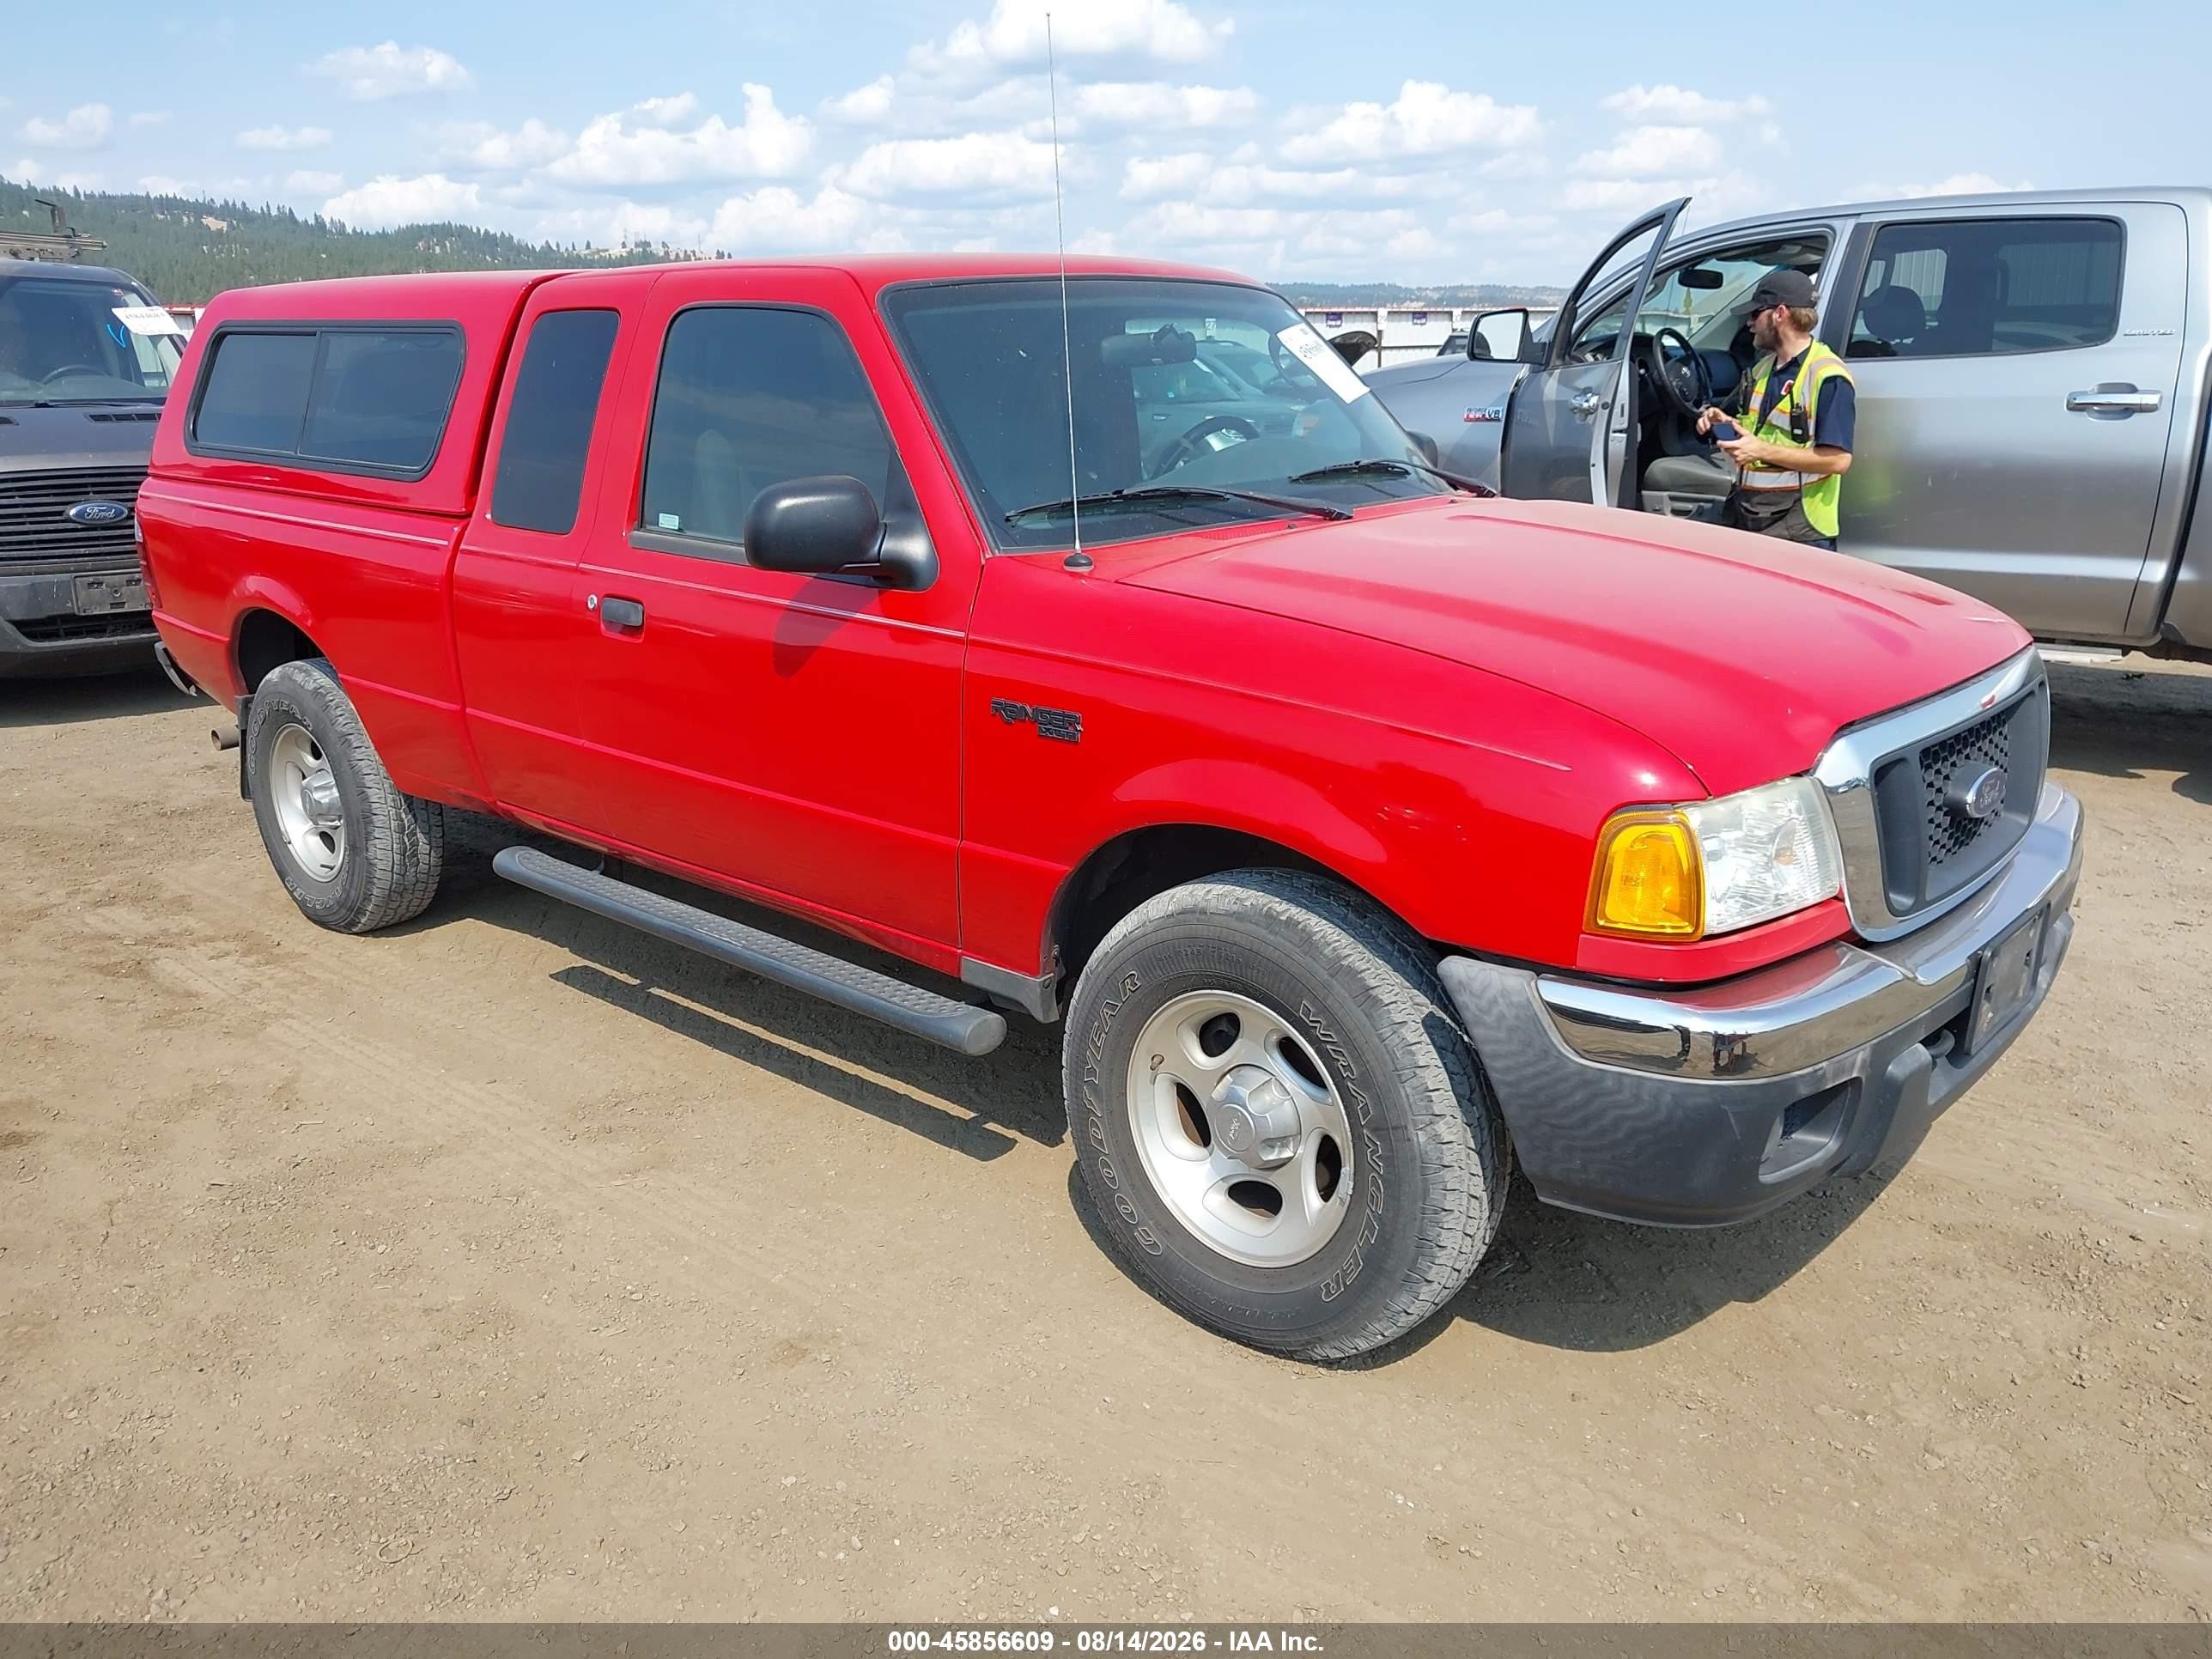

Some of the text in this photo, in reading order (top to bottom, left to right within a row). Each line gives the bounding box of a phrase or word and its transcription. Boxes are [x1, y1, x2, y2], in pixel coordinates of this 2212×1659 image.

[84, 506, 117, 520] Ford
[990, 697, 1084, 732] RANGER
[1084, 969, 1163, 1255] GOODYEAR
[1299, 1000, 1385, 1303] WRANGLER
